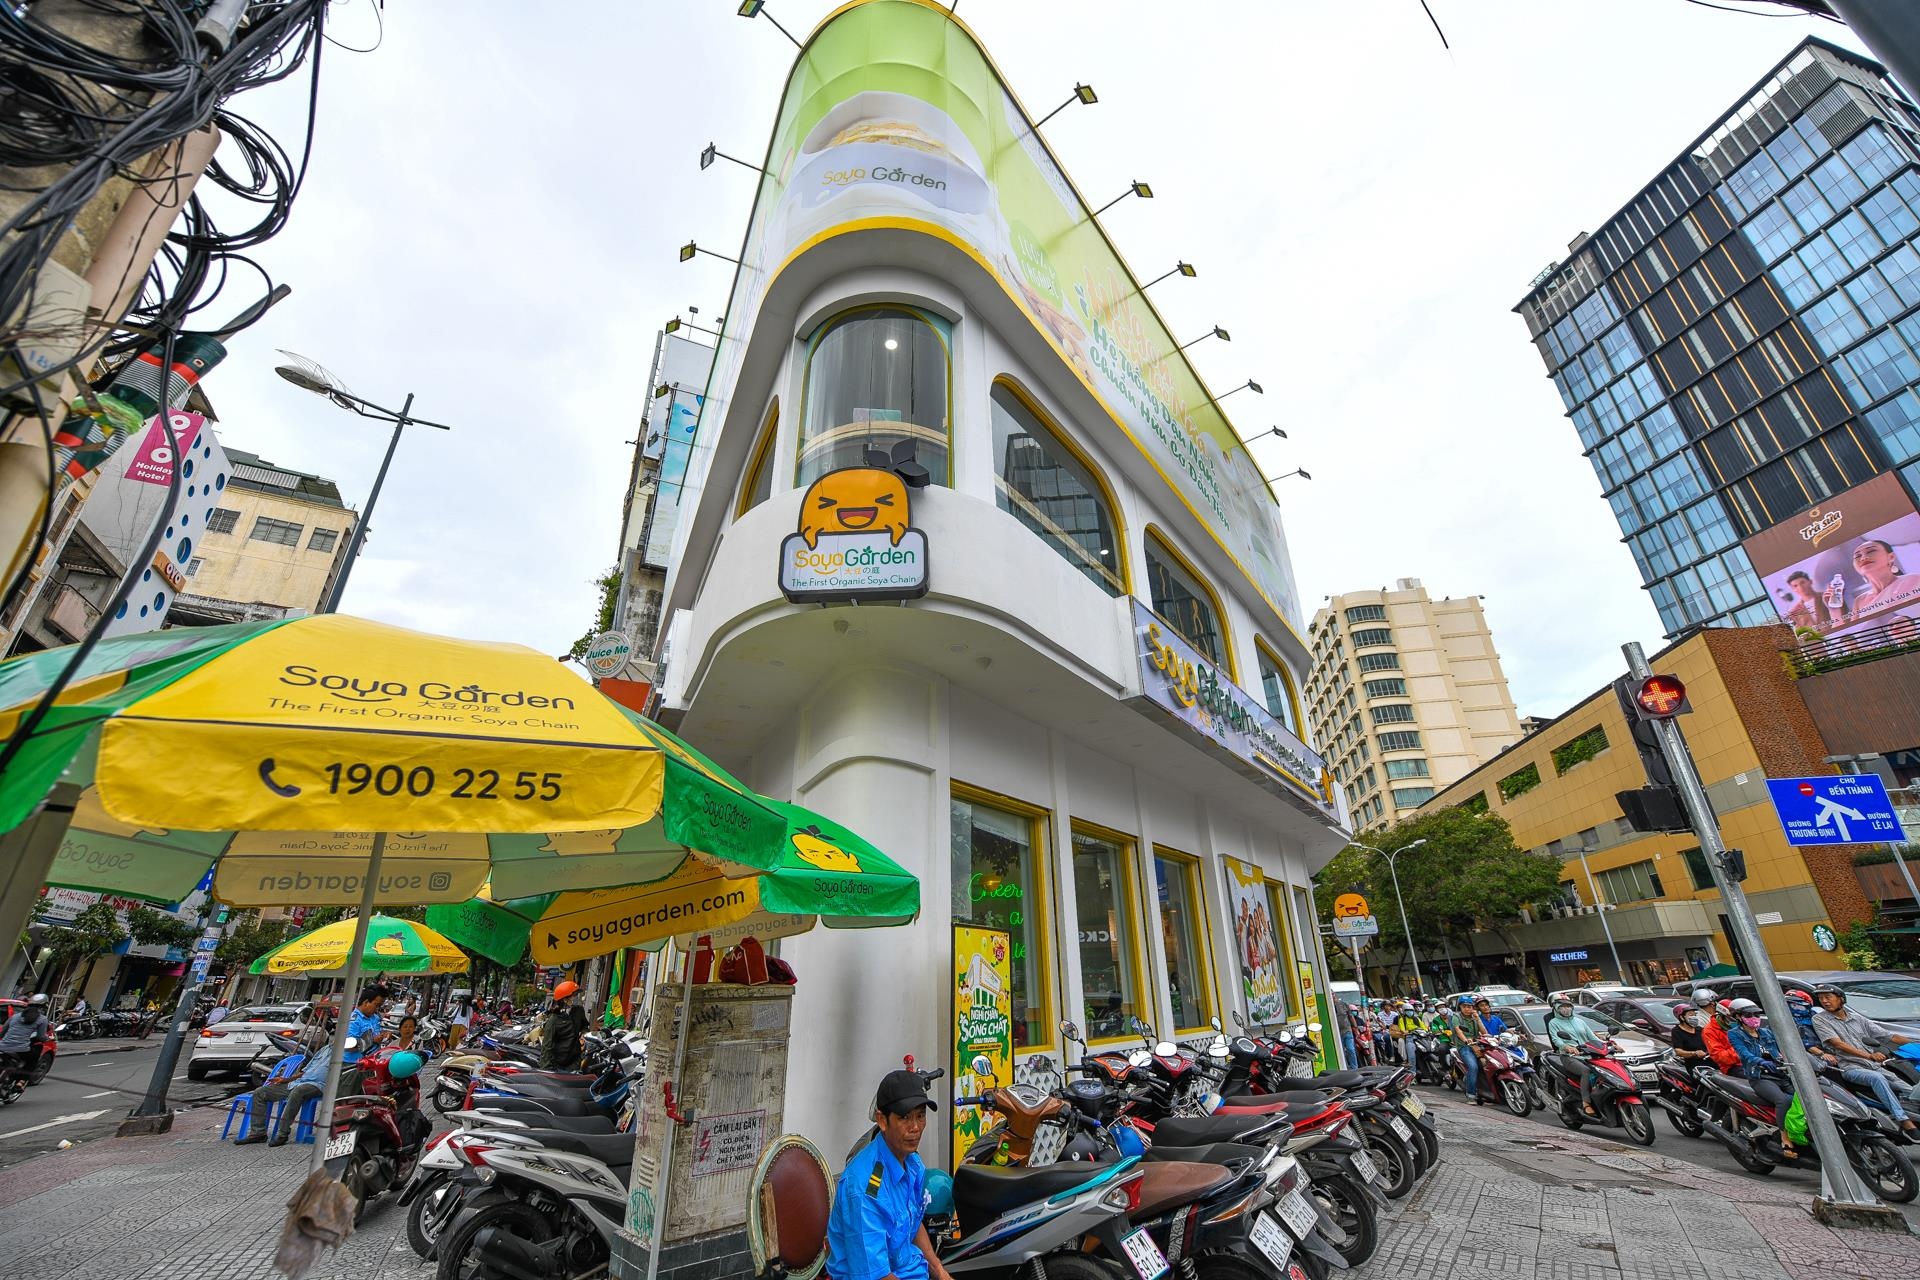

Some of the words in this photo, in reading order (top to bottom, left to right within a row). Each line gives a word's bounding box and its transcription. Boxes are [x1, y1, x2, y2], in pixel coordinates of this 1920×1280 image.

[822, 168, 866, 186] Soya
[871, 166, 947, 191] Garden
[136, 462, 173, 474] Holiday
[137, 471, 166, 480] Hotel
[791, 578, 807, 588] The
[809, 577, 827, 588] First
[829, 576, 866, 587] Organic
[867, 574, 888, 584] Soya
[890, 573, 917, 584] Chain
[586, 648, 612, 660] Juice
[614, 645, 629, 655] Me
[280, 665, 408, 700] Soya
[418, 683, 575, 710] Garden
[268, 697, 311, 711] The
[319, 702, 366, 716] First
[374, 708, 466, 722] Organic
[471, 714, 518, 727] Soya
[523, 718, 580, 730] Chain
[323, 762, 435, 798] 1900
[450, 768, 501, 800] 22
[513, 771, 563, 801] 55
[1839, 777, 1856, 785] CHỢ
[1829, 785, 1846, 796] BẾN
[1847, 785, 1874, 795] THÀNH
[703, 793, 724, 825] Soya
[725, 803, 752, 832] Garden
[1882, 821, 1894, 830] LAI
[814, 878, 839, 895] Soya
[840, 879, 874, 894] Garden
[567, 889, 745, 944] soyagarden.com
[1550, 950, 1588, 962] SKECHERS
[327, 1143, 352, 1158] 02.22
